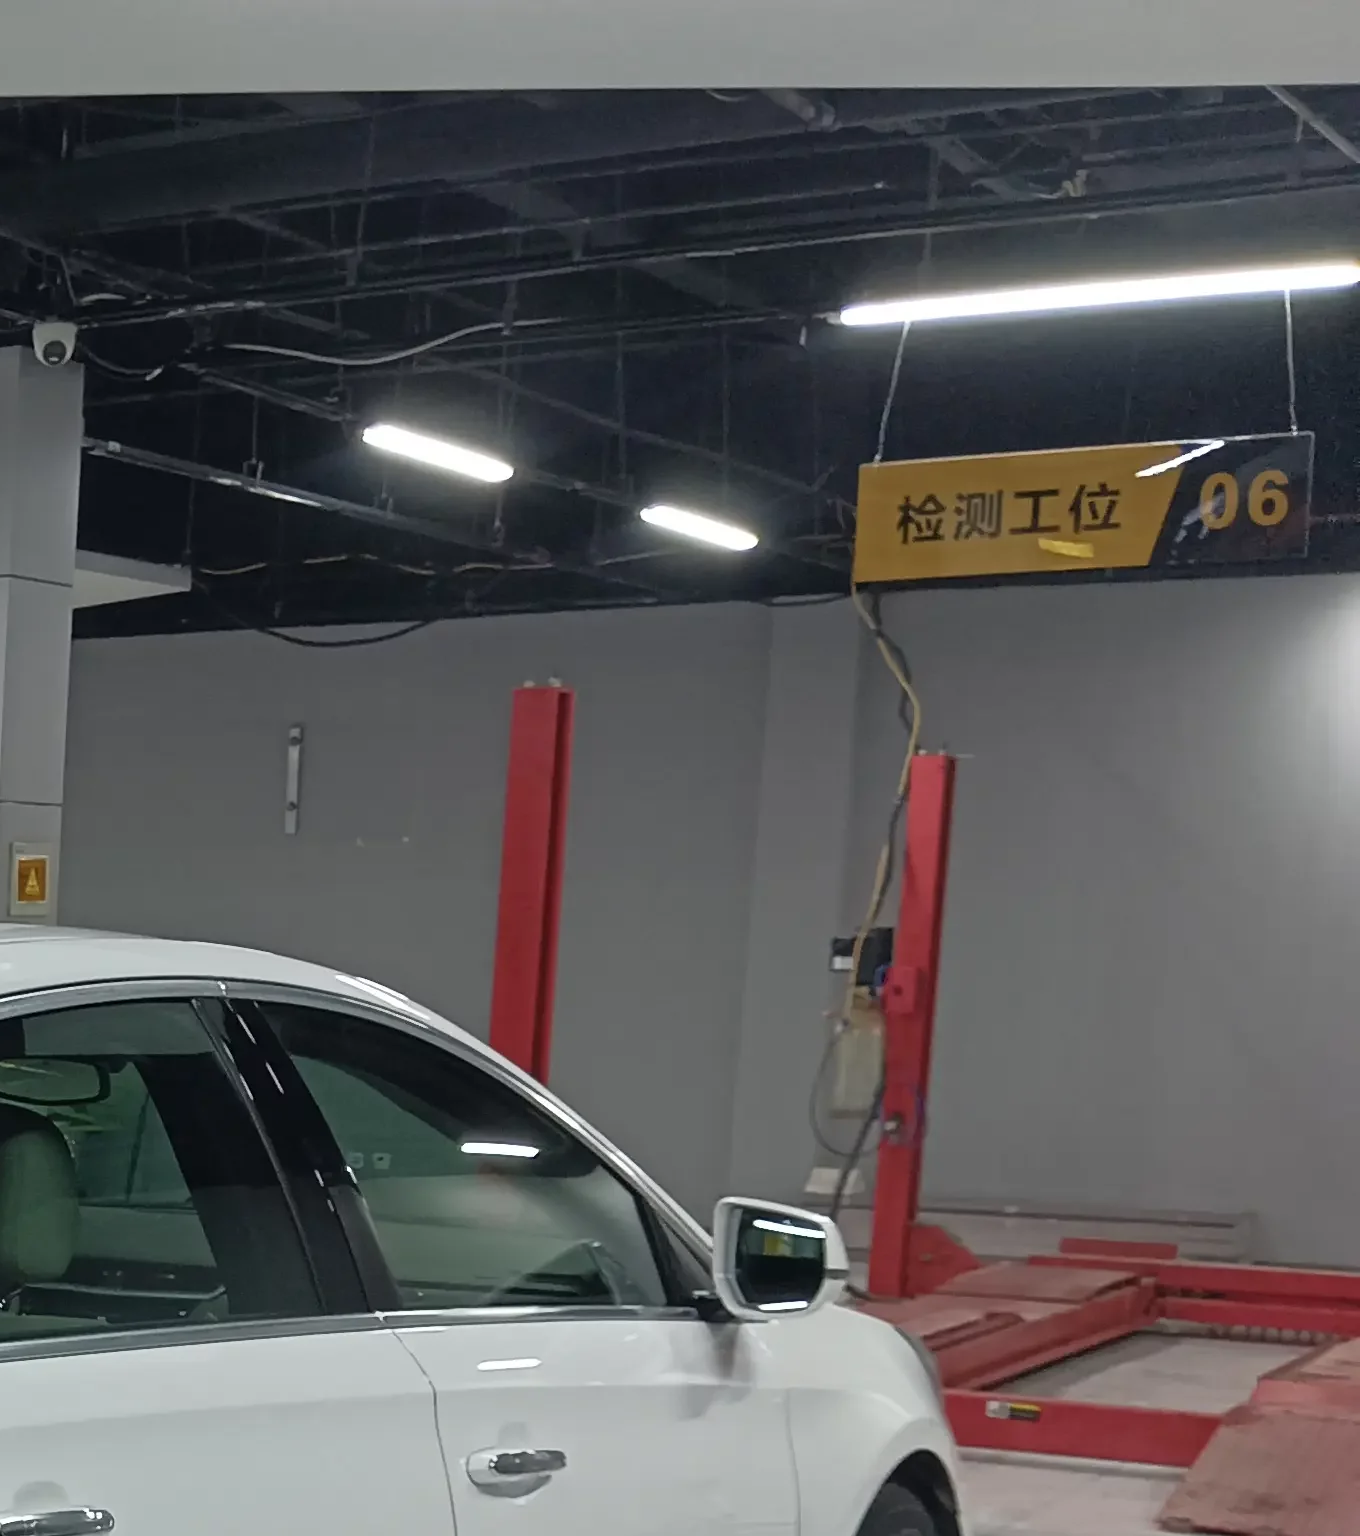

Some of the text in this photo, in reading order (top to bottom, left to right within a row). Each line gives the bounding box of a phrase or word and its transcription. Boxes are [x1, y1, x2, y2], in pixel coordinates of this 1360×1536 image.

[896, 468, 1290, 545] 检测工位 06
